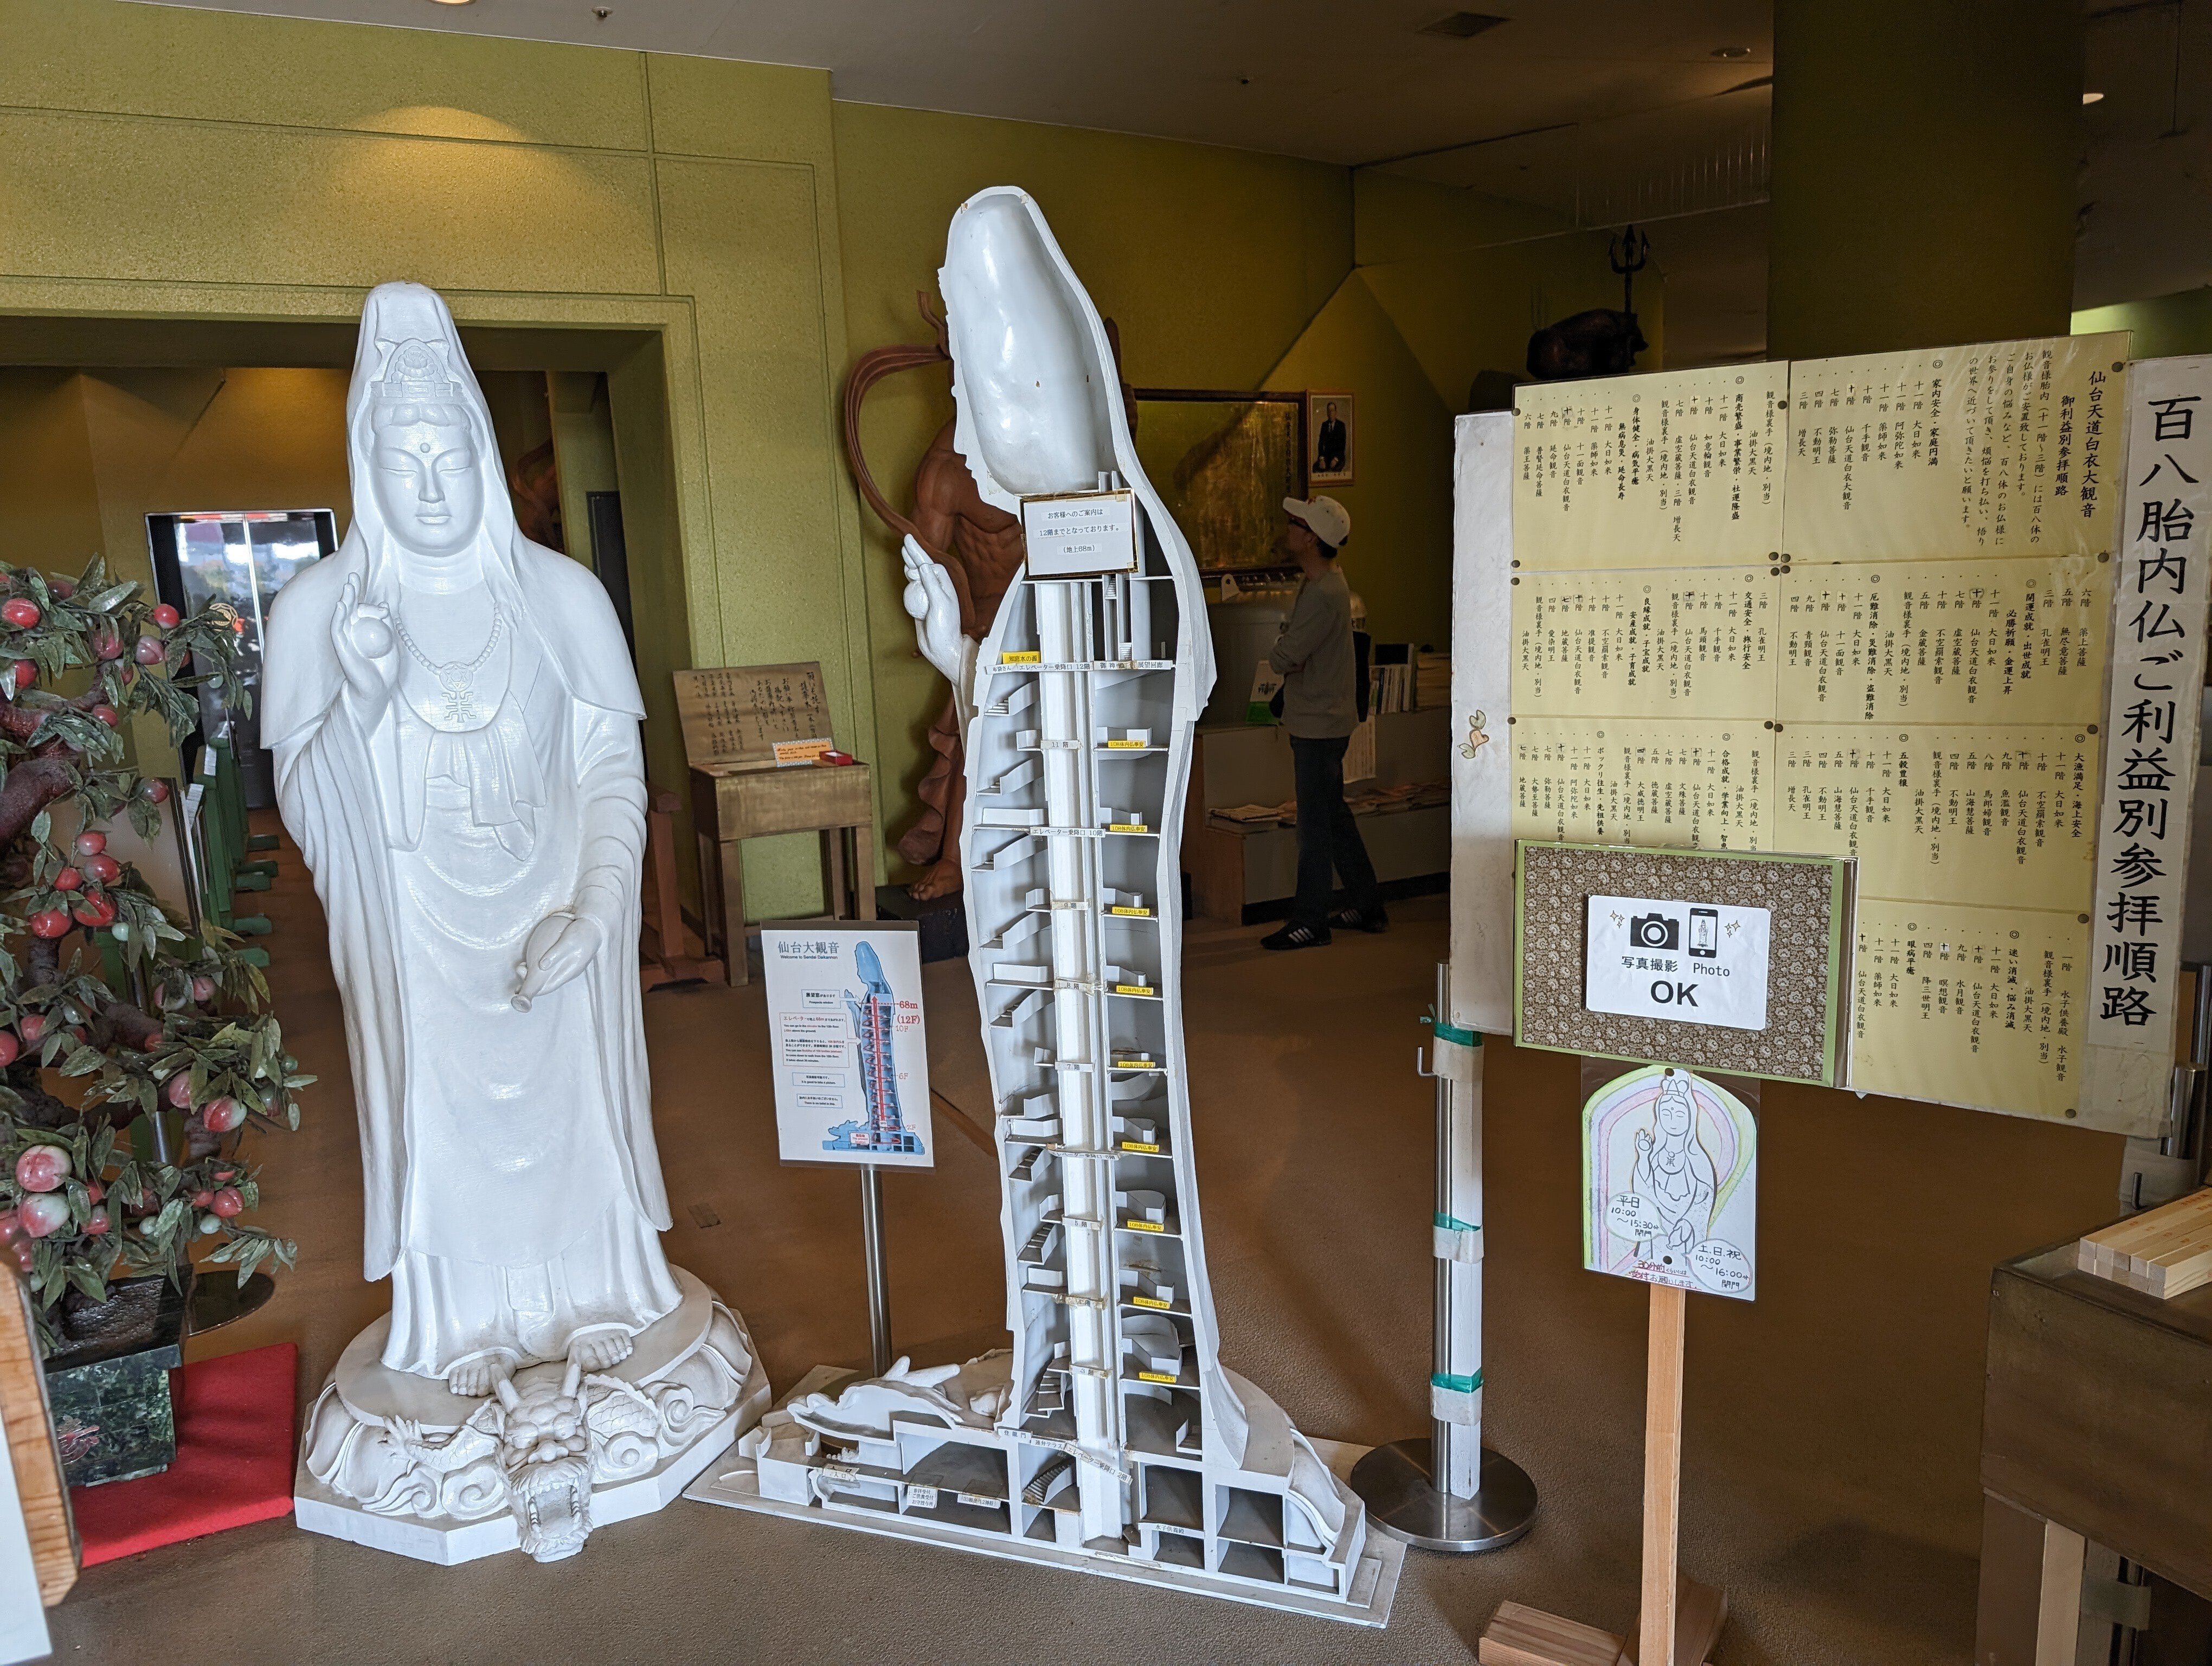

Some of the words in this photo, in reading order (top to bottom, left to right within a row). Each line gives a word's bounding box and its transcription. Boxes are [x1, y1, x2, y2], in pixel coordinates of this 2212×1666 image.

[1799, 392, 1808, 409] 三階
[1830, 389, 1840, 406] 七階
[1846, 385, 1856, 405] 十階
[1896, 383, 1906, 411] 十一階
[1913, 381, 1924, 409] 十一階
[1676, 400, 1683, 416] 七階
[1705, 397, 1713, 414] 十階
[1524, 414, 1531, 429] 六階
[1550, 411, 1558, 427] 九階
[1928, 379, 1942, 466] 家内安全・家庭円満
[2017, 352, 2033, 496] お仏様がご安置致しております。
[2055, 395, 2075, 496] 御利益別参拝順路
[2081, 371, 2106, 517] 仙台天道白衣大観音
[1047, 509, 1103, 520] お客様へのご案内は
[1548, 598, 1556, 612] 四階
[1589, 596, 1596, 611] 十階
[1699, 592, 1708, 608] 十階
[1714, 593, 1722, 609] 十階
[1790, 597, 1799, 612] 四階
[1920, 592, 1930, 609] 五階
[2062, 588, 2073, 606] 五階
[2081, 589, 2091, 607] 六階
[1742, 591, 1753, 669] 交通安全・旅行安全
[2100, 395, 2202, 1027] 百八胎内仏ご利益別参拝順路
[1532, 746, 1539, 761] 七階
[1636, 747, 1646, 764] 四階
[1651, 748, 1659, 764] 五階
[1679, 749, 1687, 765] 七階
[1788, 752, 1796, 767] 三階
[1967, 752, 1977, 769] 五階
[2002, 752, 2012, 770] 九階
[1984, 754, 1994, 770] 八階
[2072, 753, 2085, 837] 大漁満足・海上安全
[778, 941, 839, 954] 仙台大観音
[1923, 943, 1933, 958] 四階
[1957, 944, 1967, 961] 九階
[1621, 956, 1679, 973] 写真撮影
[1693, 963, 1730, 978] Photo
[2062, 957, 2073, 971] 一階
[1651, 981, 1699, 1008] OK
[899, 1001, 918, 1009] 68m
[897, 1014, 921, 1024] (12F)
[1616, 1195, 1639, 1208] 平日
[1611, 1207, 1636, 1217] 10:00
[1635, 1229, 1652, 1238] 閉門
[1695, 1254, 1721, 1265] 10:00
[1722, 1279, 1740, 1290] 閉門
